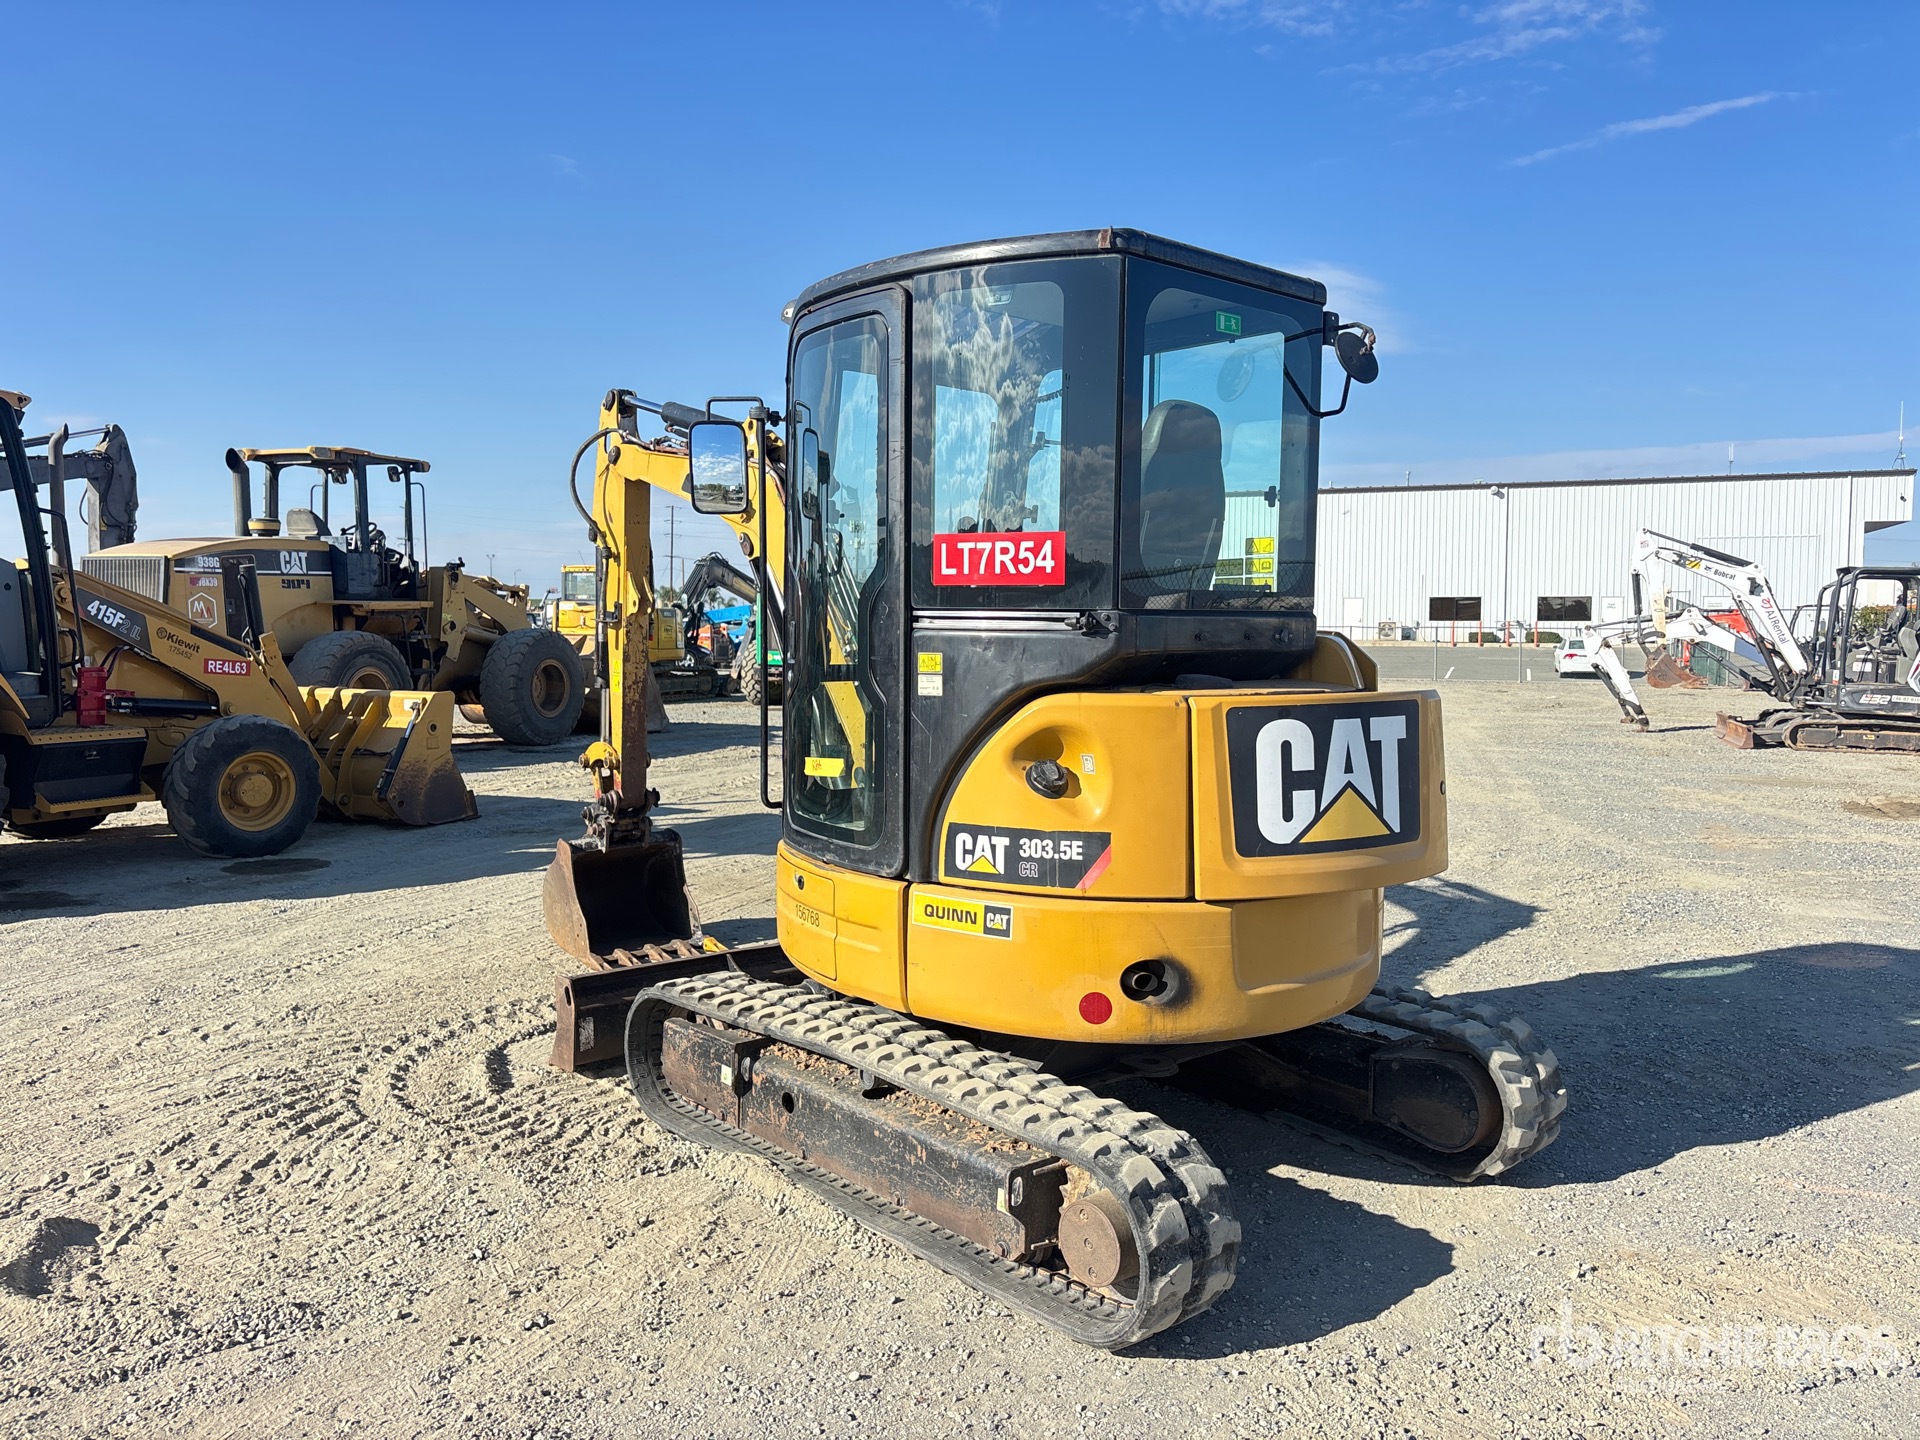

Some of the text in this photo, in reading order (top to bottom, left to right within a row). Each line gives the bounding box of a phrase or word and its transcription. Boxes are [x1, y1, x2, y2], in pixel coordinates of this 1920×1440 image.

[198, 557, 220, 568] 938G
[280, 551, 307, 574] CAT
[941, 540, 1055, 575] LT7R54
[1713, 569, 1736, 580] Bobcat
[166, 632, 201, 653] Kiewit
[169, 645, 193, 660] 175452
[207, 661, 247, 675] RE4L63
[1256, 715, 1406, 845] CAT
[955, 832, 1083, 875] CAT 303.5E
[1019, 862, 1038, 877] CR
[795, 903, 820, 928] 156768
[924, 904, 1010, 930] QUINN CAT
